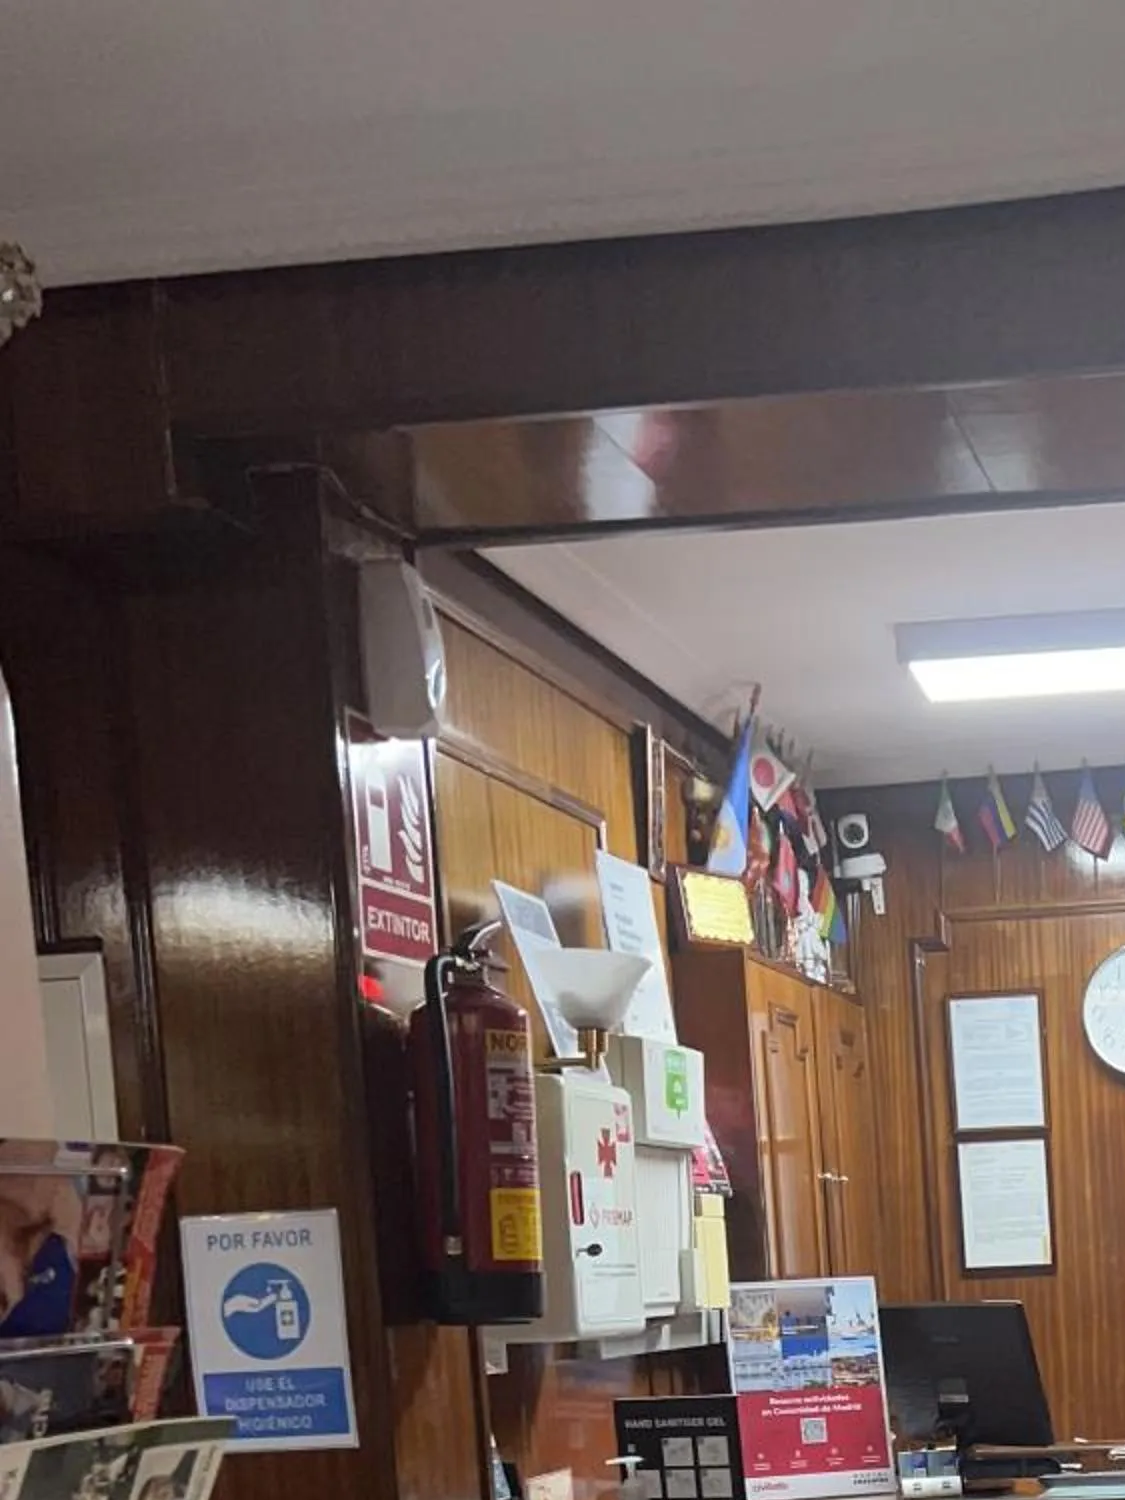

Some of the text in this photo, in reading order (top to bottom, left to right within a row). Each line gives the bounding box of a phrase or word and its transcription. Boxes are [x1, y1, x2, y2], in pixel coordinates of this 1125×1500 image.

[367, 905, 431, 944] EXTINTOR
[207, 1229, 314, 1250] POR FAVOR
[245, 1375, 296, 1391] USE EL
[224, 1393, 327, 1411] DISPENSADOR
[625, 1419, 653, 1429] HAND
[706, 1416, 726, 1427] GEL
